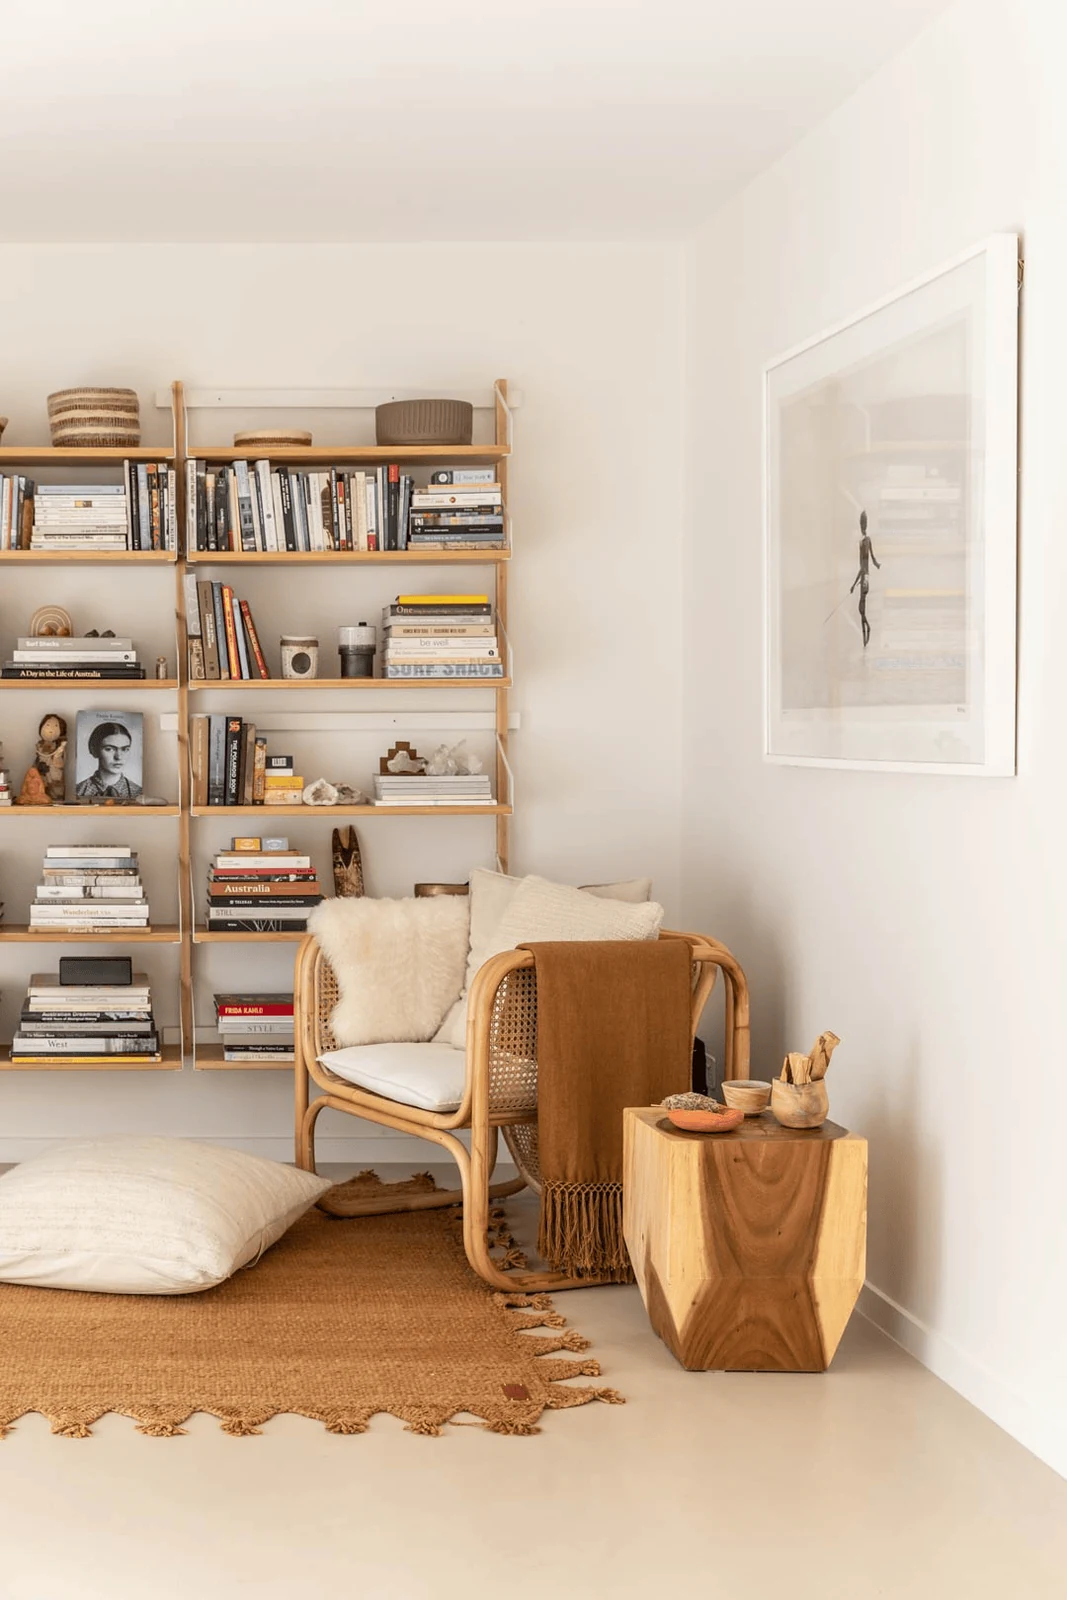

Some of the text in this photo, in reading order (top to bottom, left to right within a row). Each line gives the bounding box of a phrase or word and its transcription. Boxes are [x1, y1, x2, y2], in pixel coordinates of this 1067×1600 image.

[396, 605, 413, 614] One
[224, 884, 270, 893] Australia
[48, 1040, 68, 1048] West
